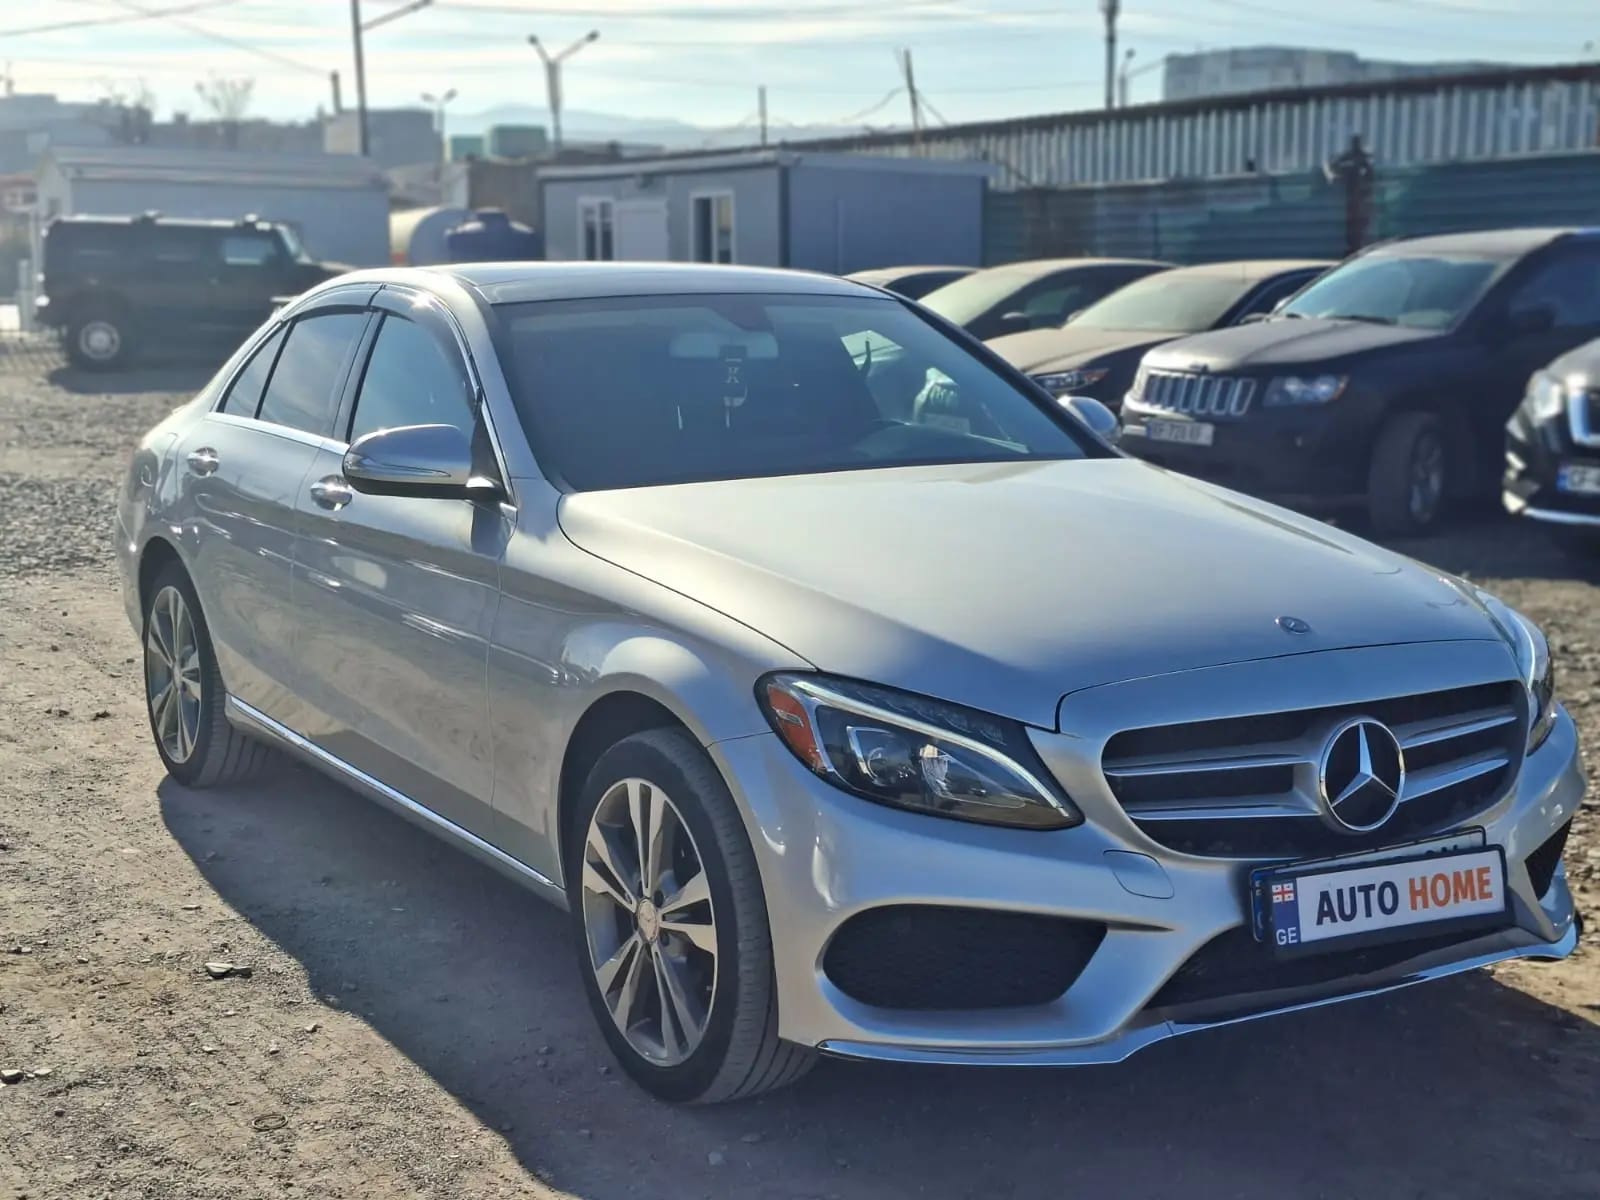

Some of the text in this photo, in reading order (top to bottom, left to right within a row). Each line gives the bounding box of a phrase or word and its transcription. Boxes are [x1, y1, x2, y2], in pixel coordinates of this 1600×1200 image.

[1316, 866, 1493, 926] AUTO HOME
[1276, 927, 1298, 946] GE
